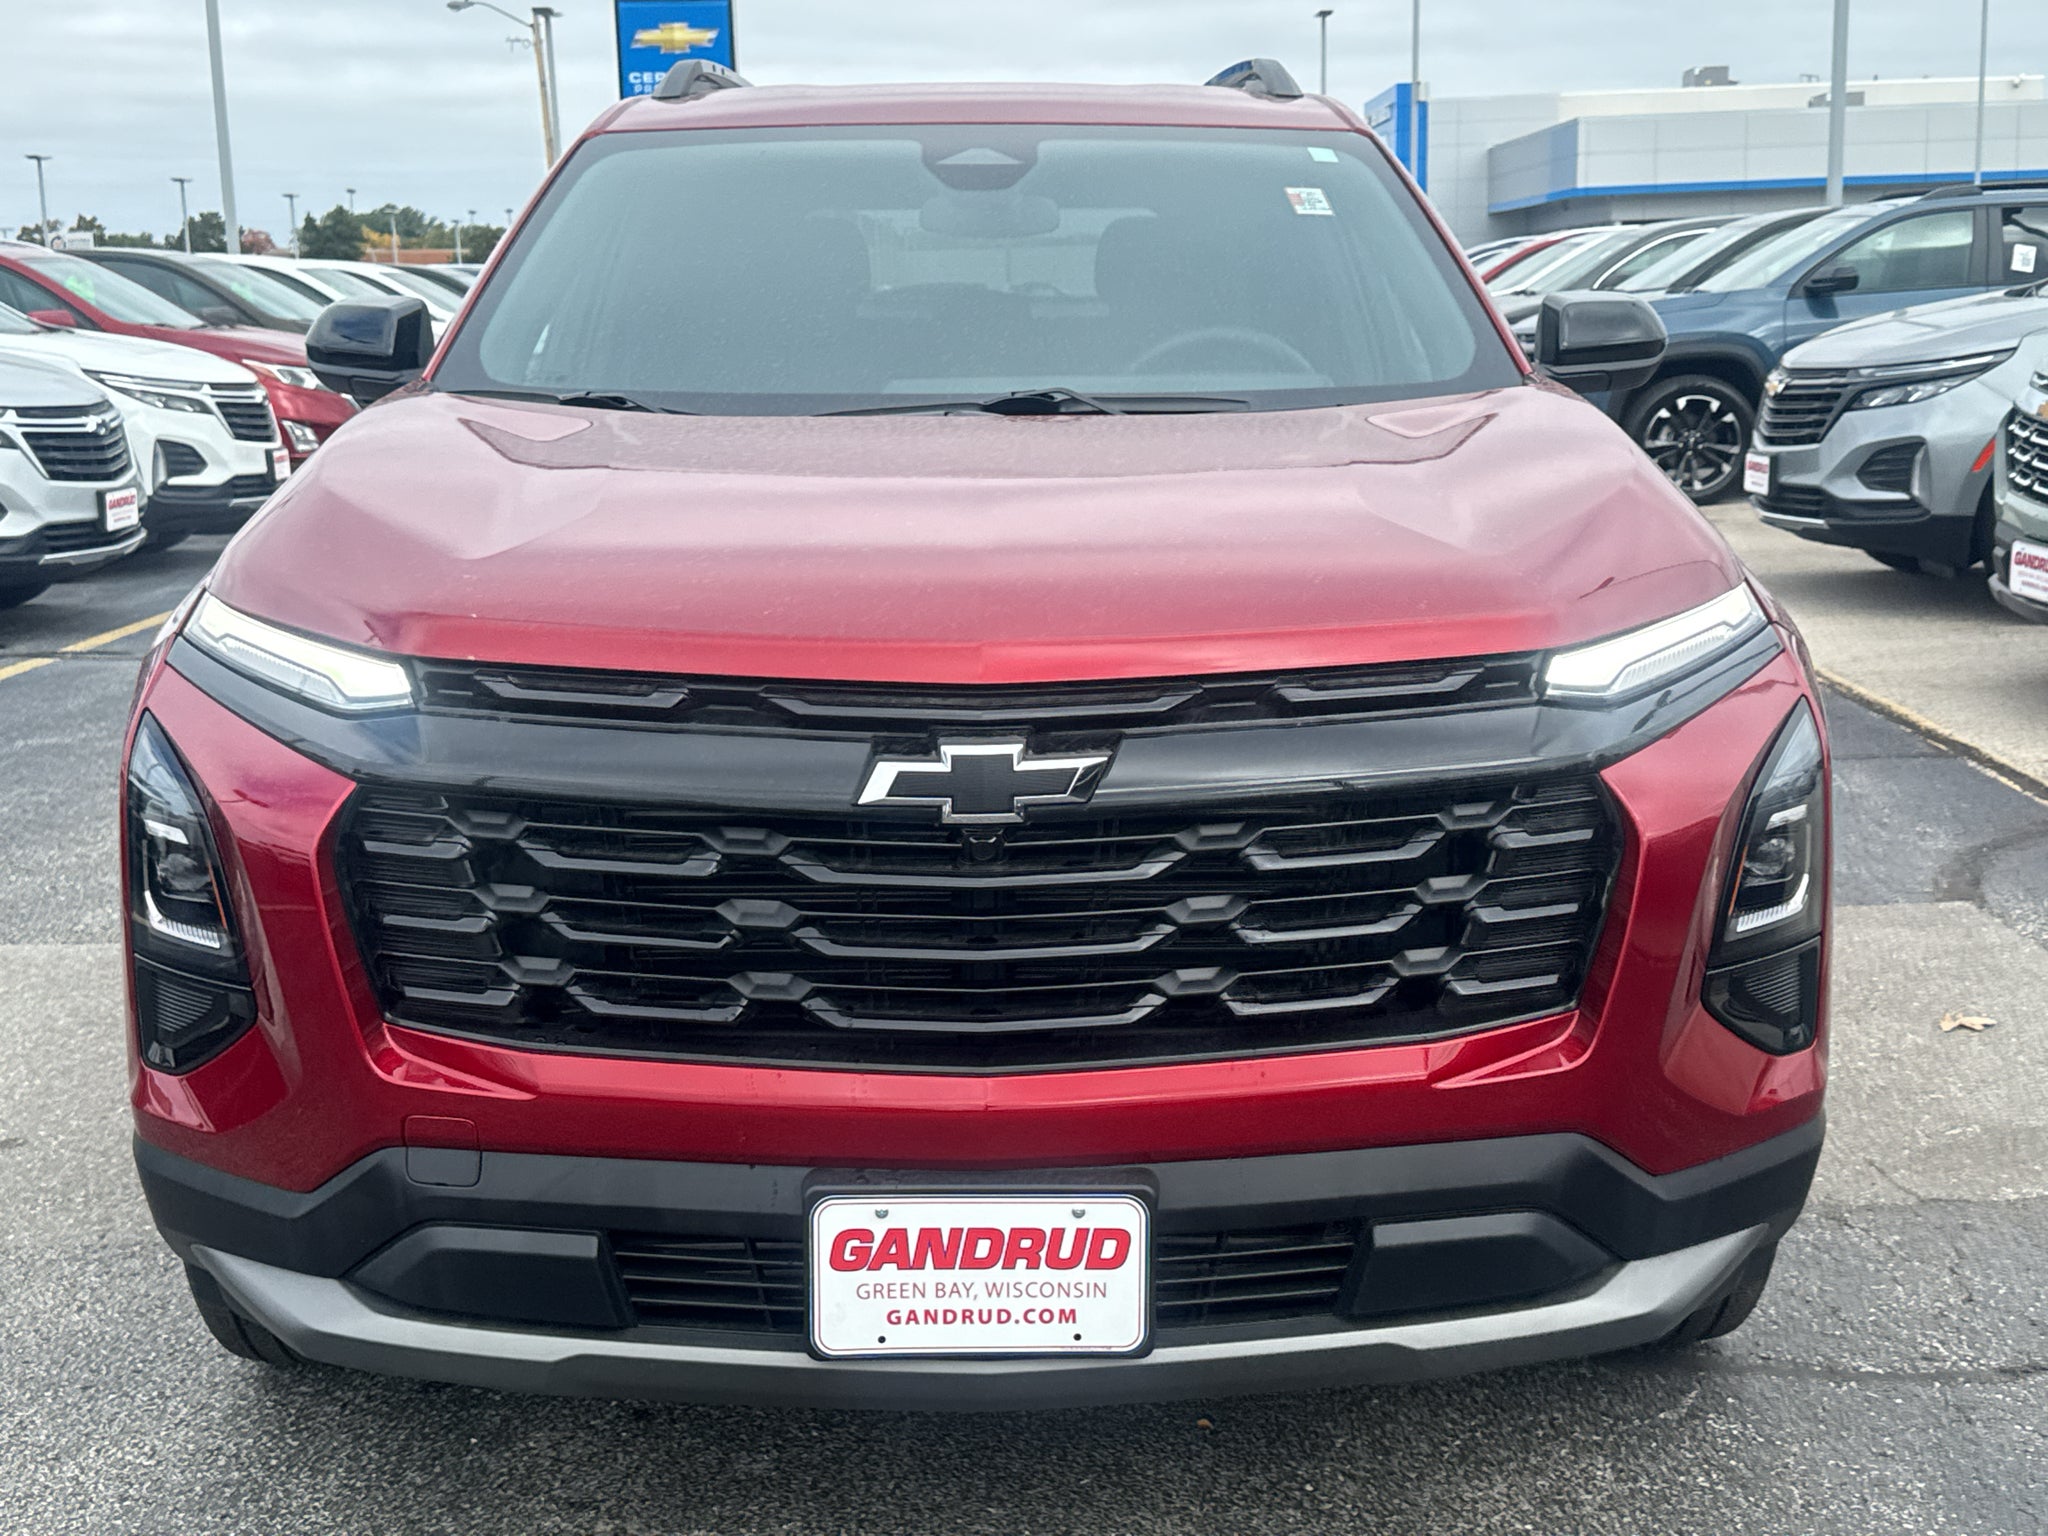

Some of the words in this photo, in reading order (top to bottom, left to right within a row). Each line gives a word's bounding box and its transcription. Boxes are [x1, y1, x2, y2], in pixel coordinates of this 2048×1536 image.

[829, 1227, 1132, 1272] GANDRUD
[856, 1282, 926, 1300] GREEN
[934, 1281, 978, 1301] BAY,
[985, 1281, 1107, 1299] WISCONSIN
[886, 1308, 1077, 1325] GANDRUD.COM
